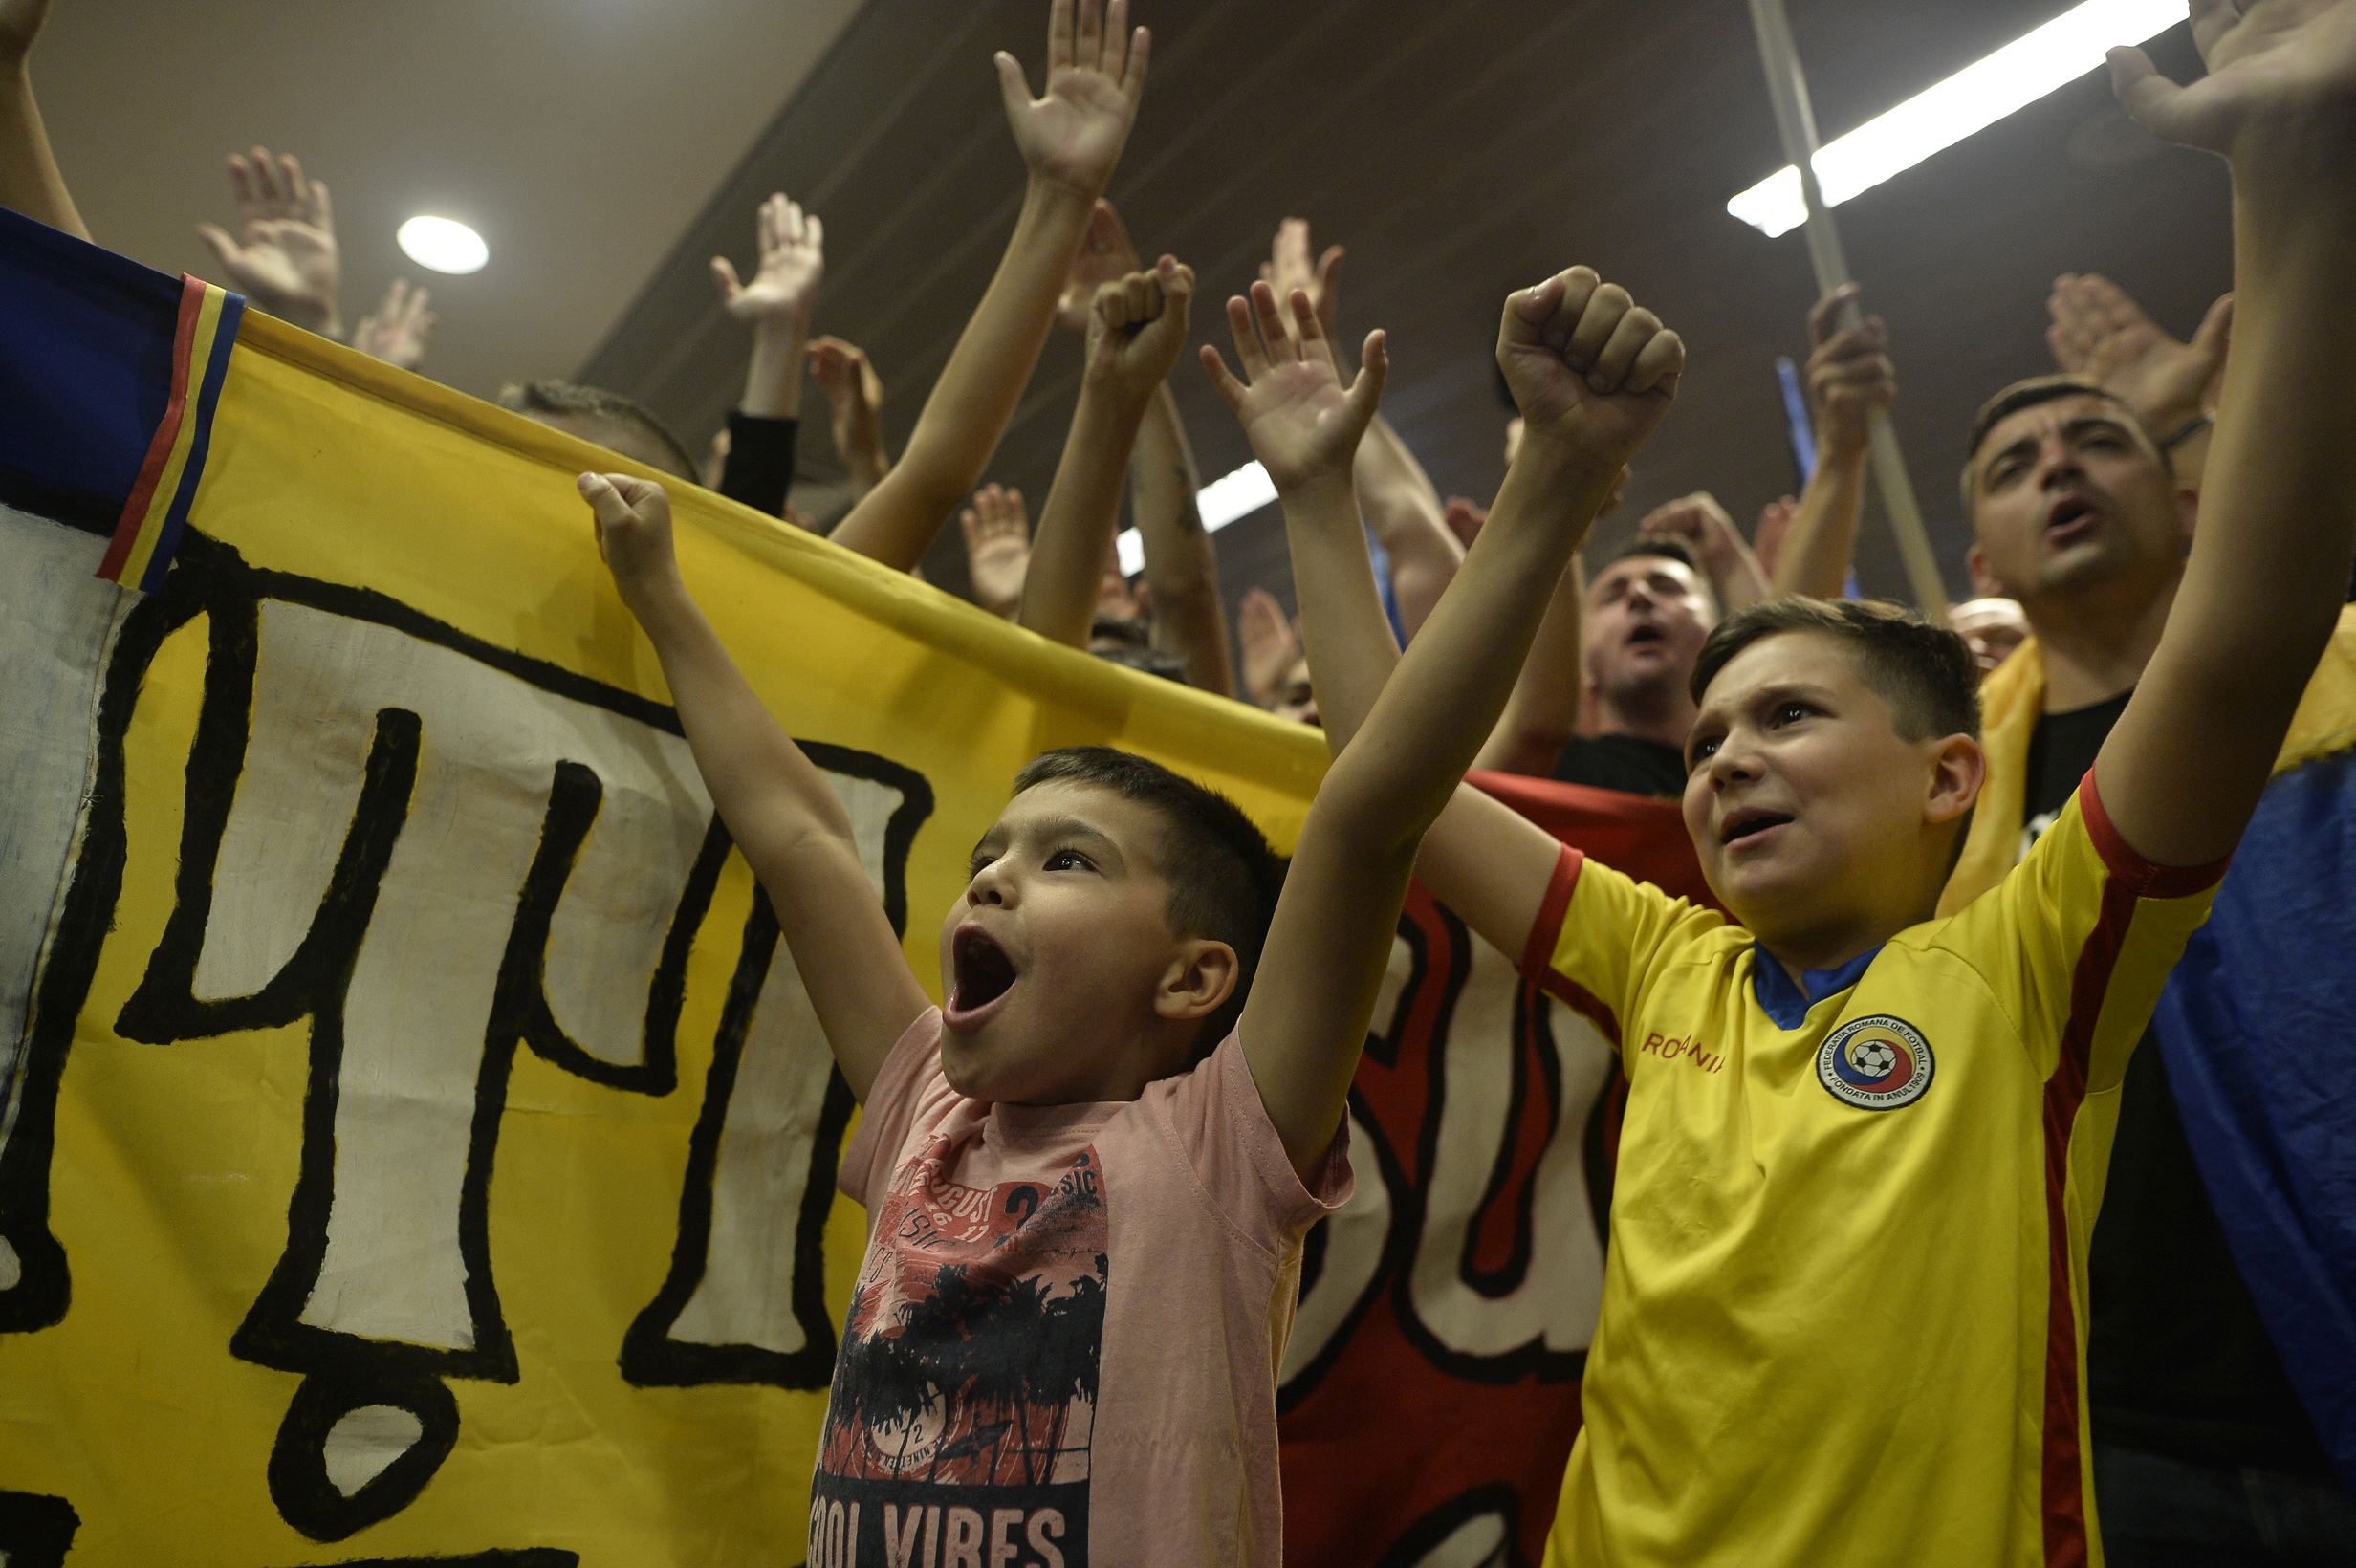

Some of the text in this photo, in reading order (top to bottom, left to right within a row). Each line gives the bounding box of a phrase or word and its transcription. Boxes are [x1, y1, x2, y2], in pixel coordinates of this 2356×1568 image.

[1890, 1022, 1905, 1034] DE
[1904, 1031, 1928, 1066] FOTBAL
[1830, 1077, 1871, 1101] FONDATA
[1887, 1087, 1913, 1101] ANUL
[1909, 1072, 1926, 1090] 1909
